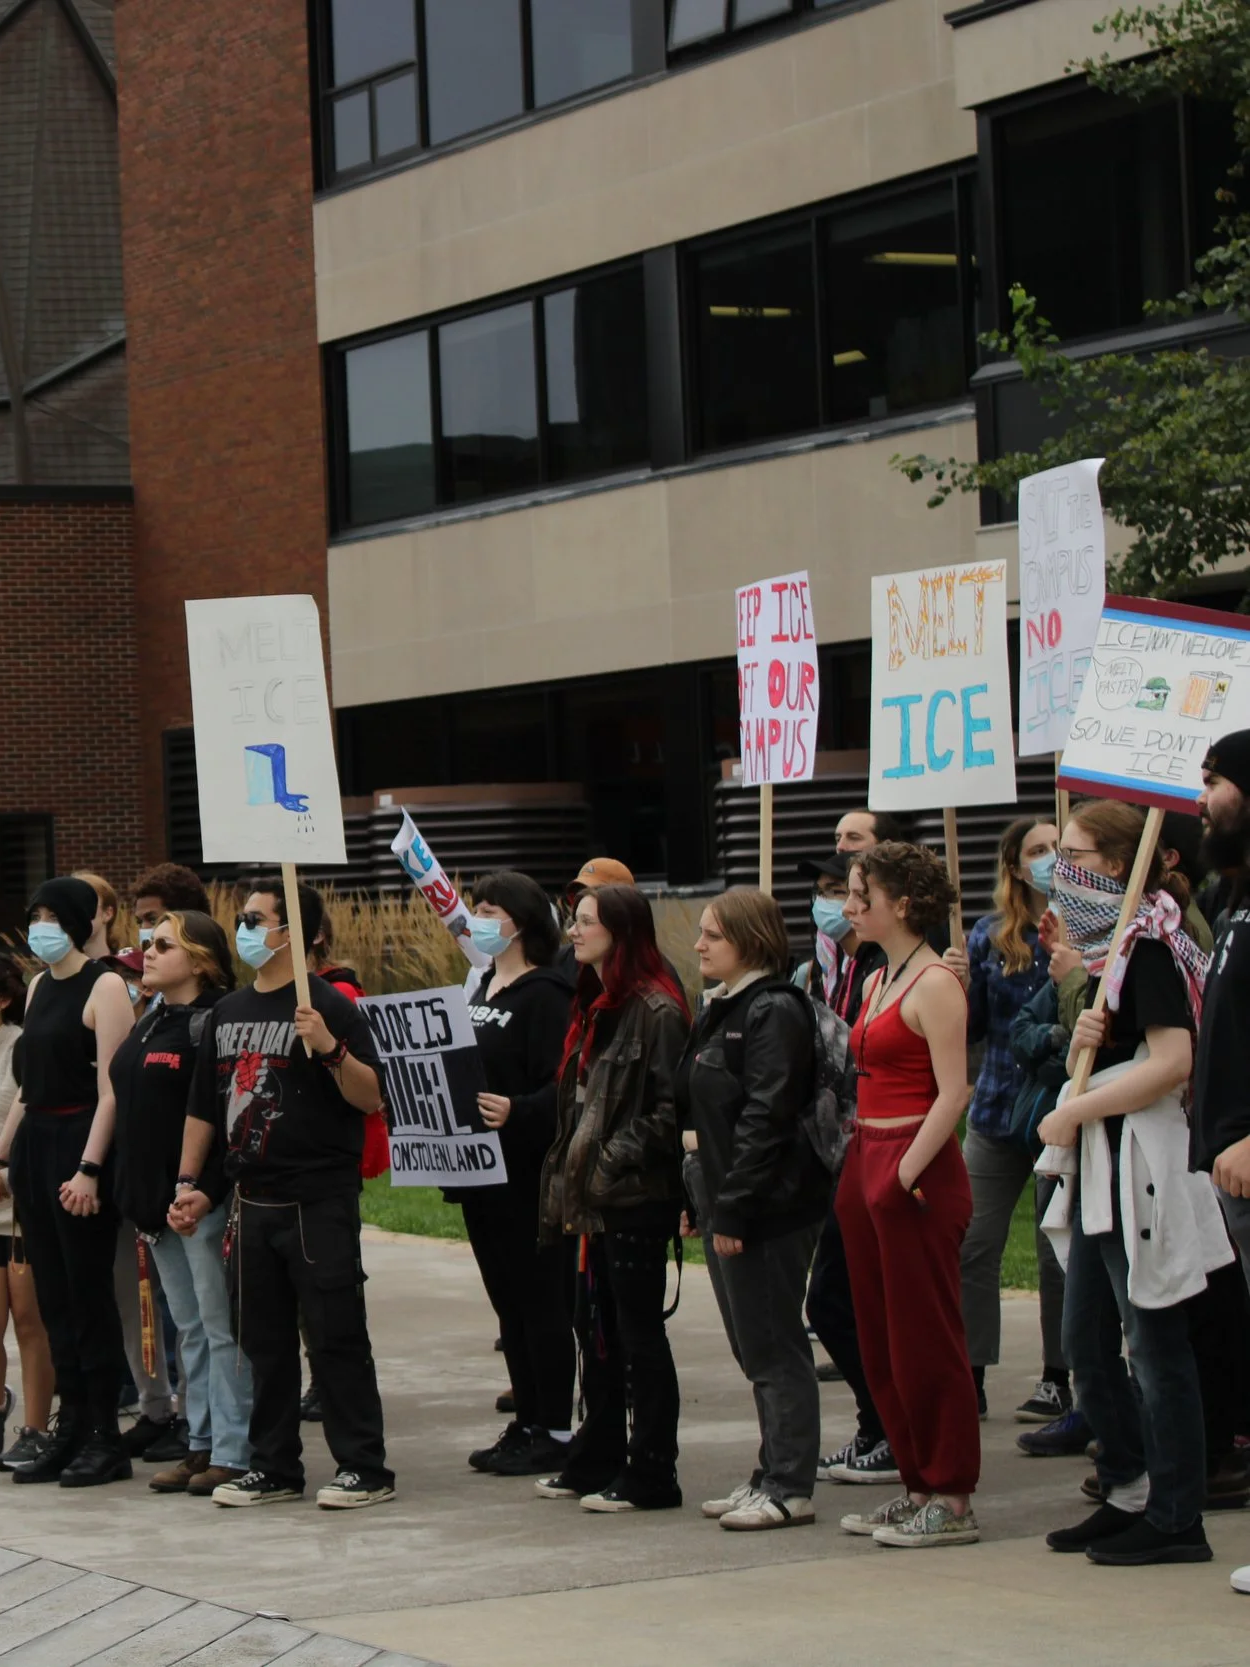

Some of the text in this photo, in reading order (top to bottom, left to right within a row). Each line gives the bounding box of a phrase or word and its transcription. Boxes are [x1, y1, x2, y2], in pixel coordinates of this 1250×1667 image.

[1022, 544, 1094, 614] CAMPUS
[737, 581, 814, 647] EEP ICE
[887, 564, 1005, 671] MELT
[1026, 607, 1062, 659] NO
[1096, 620, 1150, 649] ICE
[1181, 633, 1247, 660] WELCOME
[215, 617, 318, 668] MELT
[228, 674, 321, 725] ICE
[767, 658, 816, 712] OUR
[1026, 647, 1093, 733] ICE
[739, 717, 810, 784] AMPUS
[881, 683, 995, 779] ICE
[1069, 717, 1102, 740] SO
[1104, 724, 1137, 743] WE
[1125, 752, 1188, 776] ICE
[414, 997, 453, 1049] IS
[391, 1142, 497, 1172] ON STOLEN LAND
